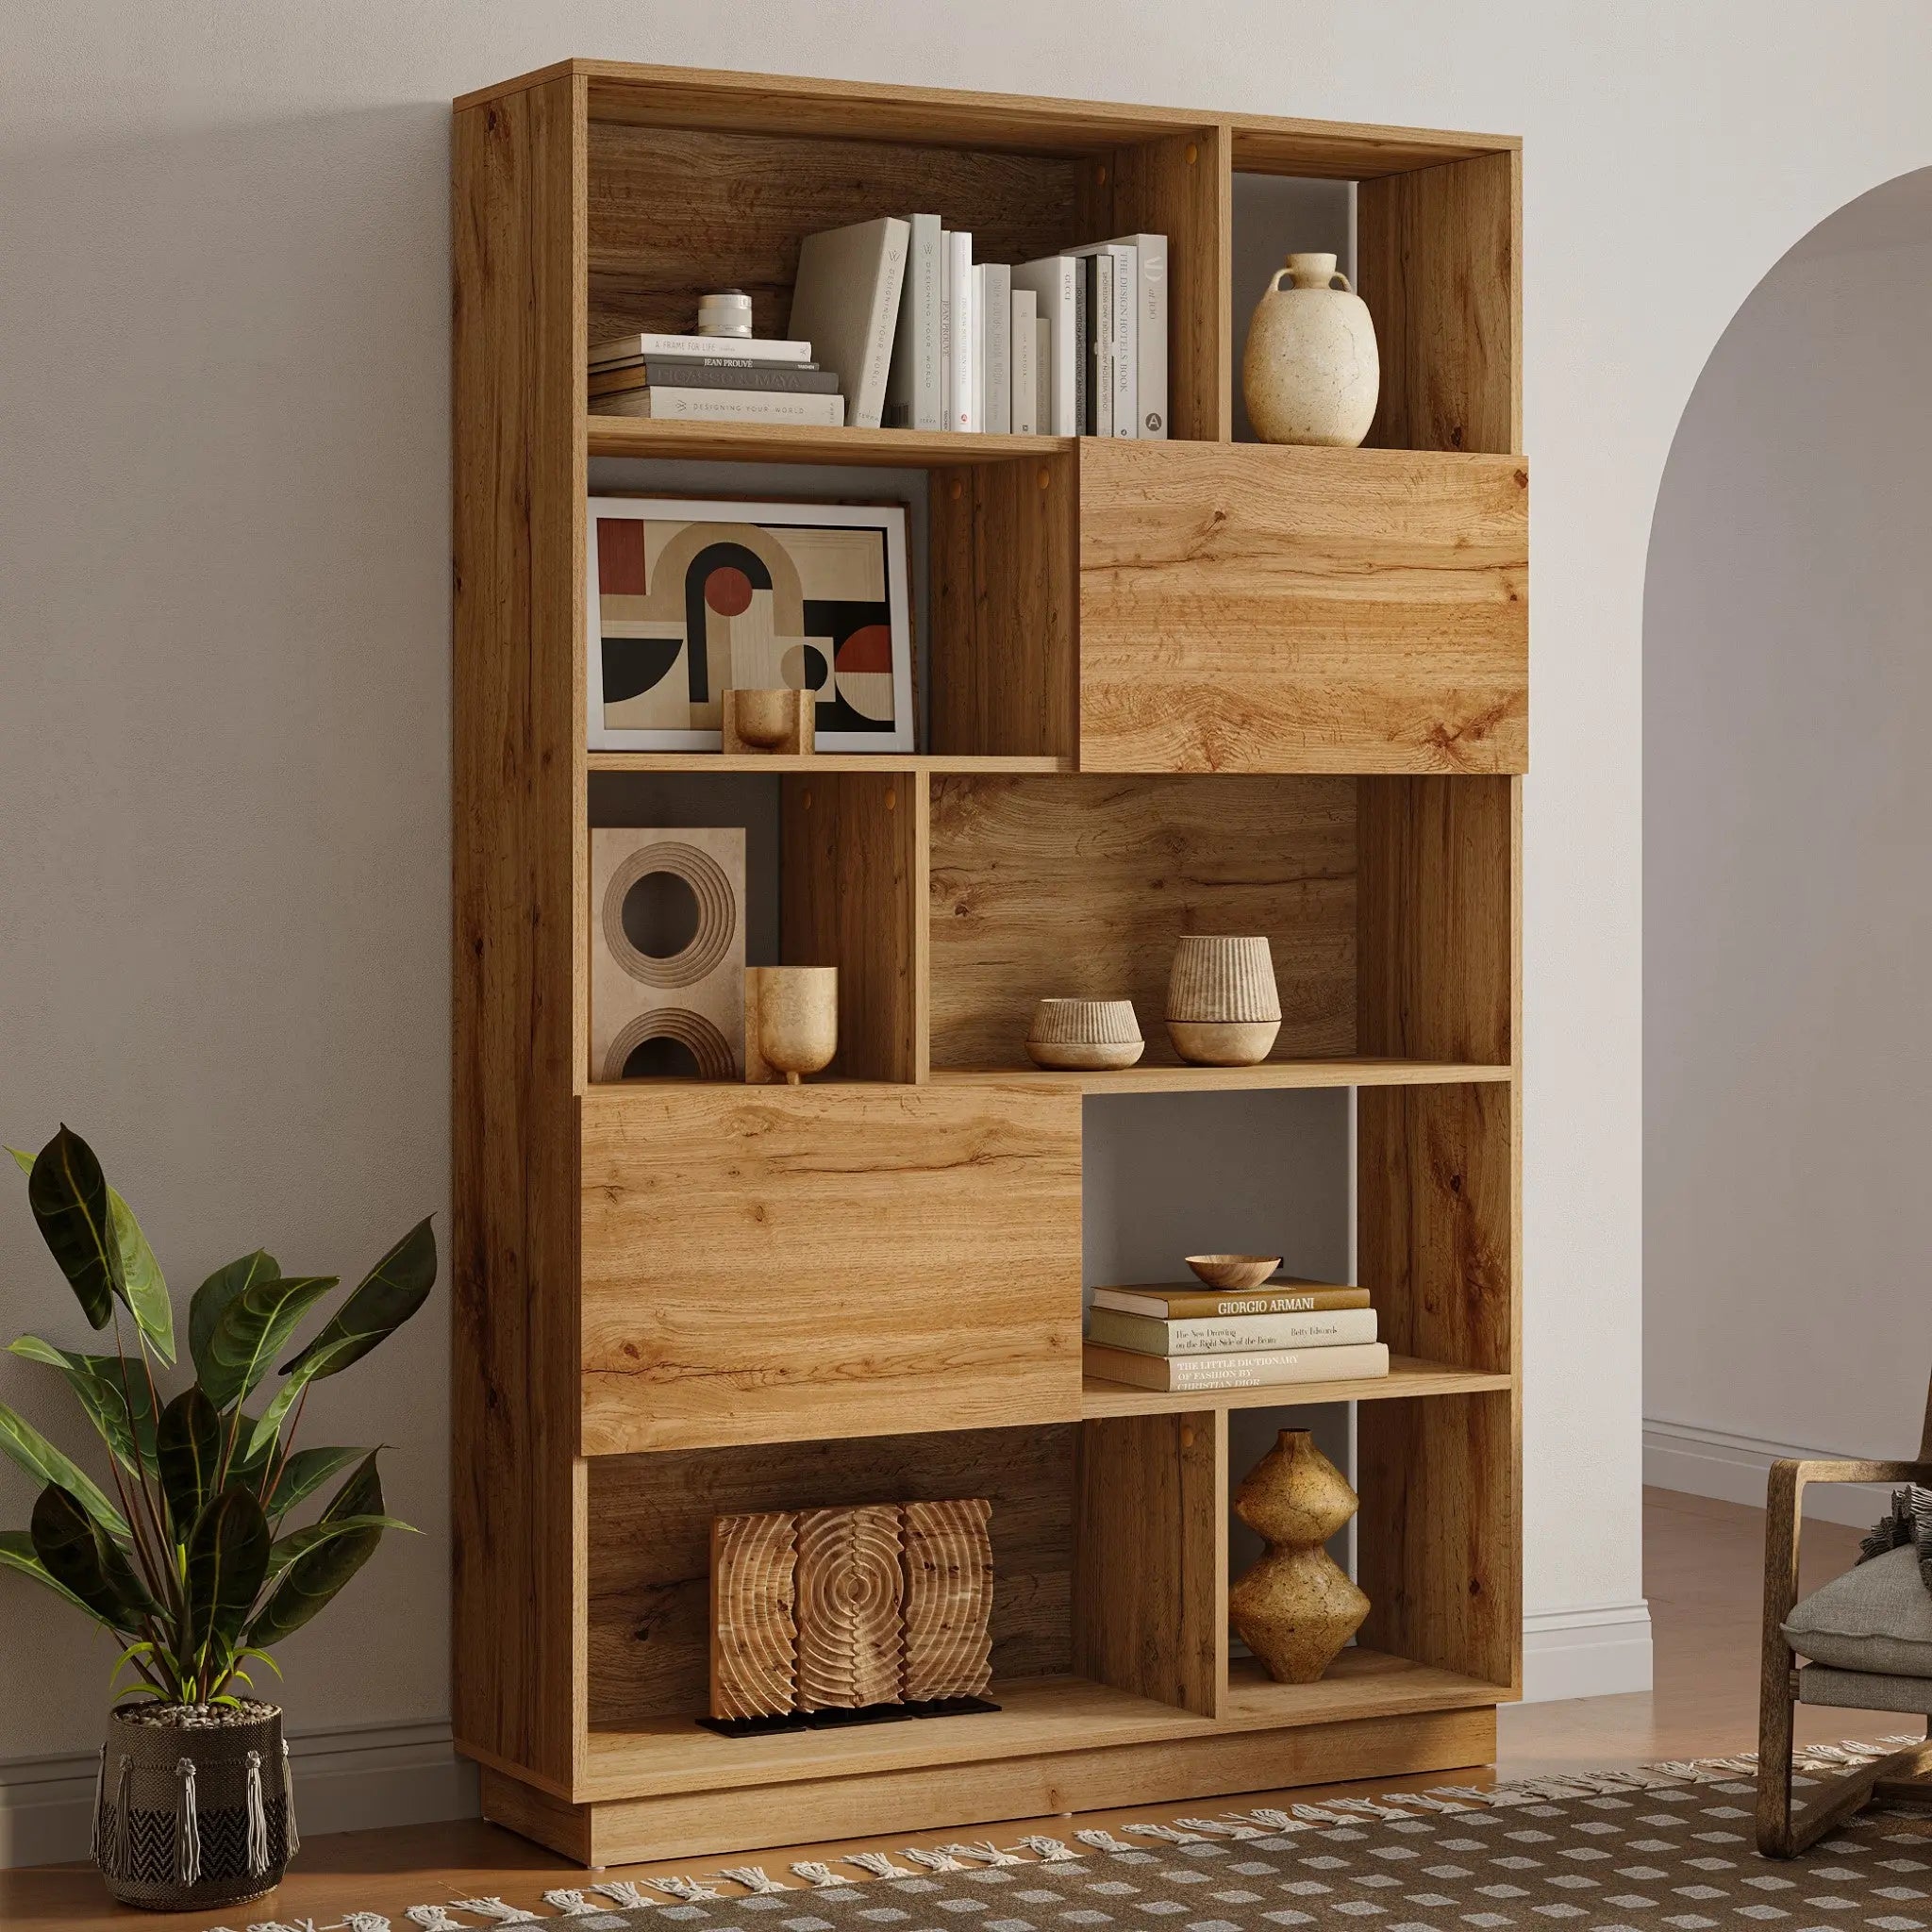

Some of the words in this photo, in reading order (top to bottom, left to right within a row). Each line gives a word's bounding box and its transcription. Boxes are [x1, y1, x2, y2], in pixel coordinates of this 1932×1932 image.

[1120, 253, 1128, 274] THE
[1120, 277, 1128, 316] DESIGN
[877, 325, 887, 348] YOUR
[1120, 319, 1128, 360] HOTELS
[662, 341, 686, 350] FRAME
[687, 341, 701, 351] FOR
[702, 342, 716, 352] LIFE
[703, 358, 723, 367] JEAN
[754, 372, 801, 389] MAYA
[1120, 364, 1128, 392] BOOK
[693, 403, 741, 412] DESIGNING
[745, 405, 769, 413] YOUR
[774, 407, 805, 415] WORLD
[1218, 1300, 1267, 1315] GIORGIO
[1269, 1297, 1314, 1311] ARMANI
[1207, 1328, 1237, 1338] Drawing
[1291, 1327, 1307, 1337] Betty
[1186, 1340, 1198, 1348] the
[1199, 1339, 1217, 1350] Right
[1219, 1338, 1235, 1347] Side
[1245, 1337, 1256, 1345] the
[1176, 1362, 1198, 1371] THE
[1200, 1359, 1236, 1370] LITTLE
[1238, 1356, 1299, 1368] DICTIONARY
[1177, 1373, 1192, 1381] OF
[1193, 1370, 1237, 1380] FASHION
[1239, 1369, 1253, 1377] BY
[1177, 1380, 1231, 1391] CHRISTIAN
[1235, 1378, 1259, 1387] DIOR
